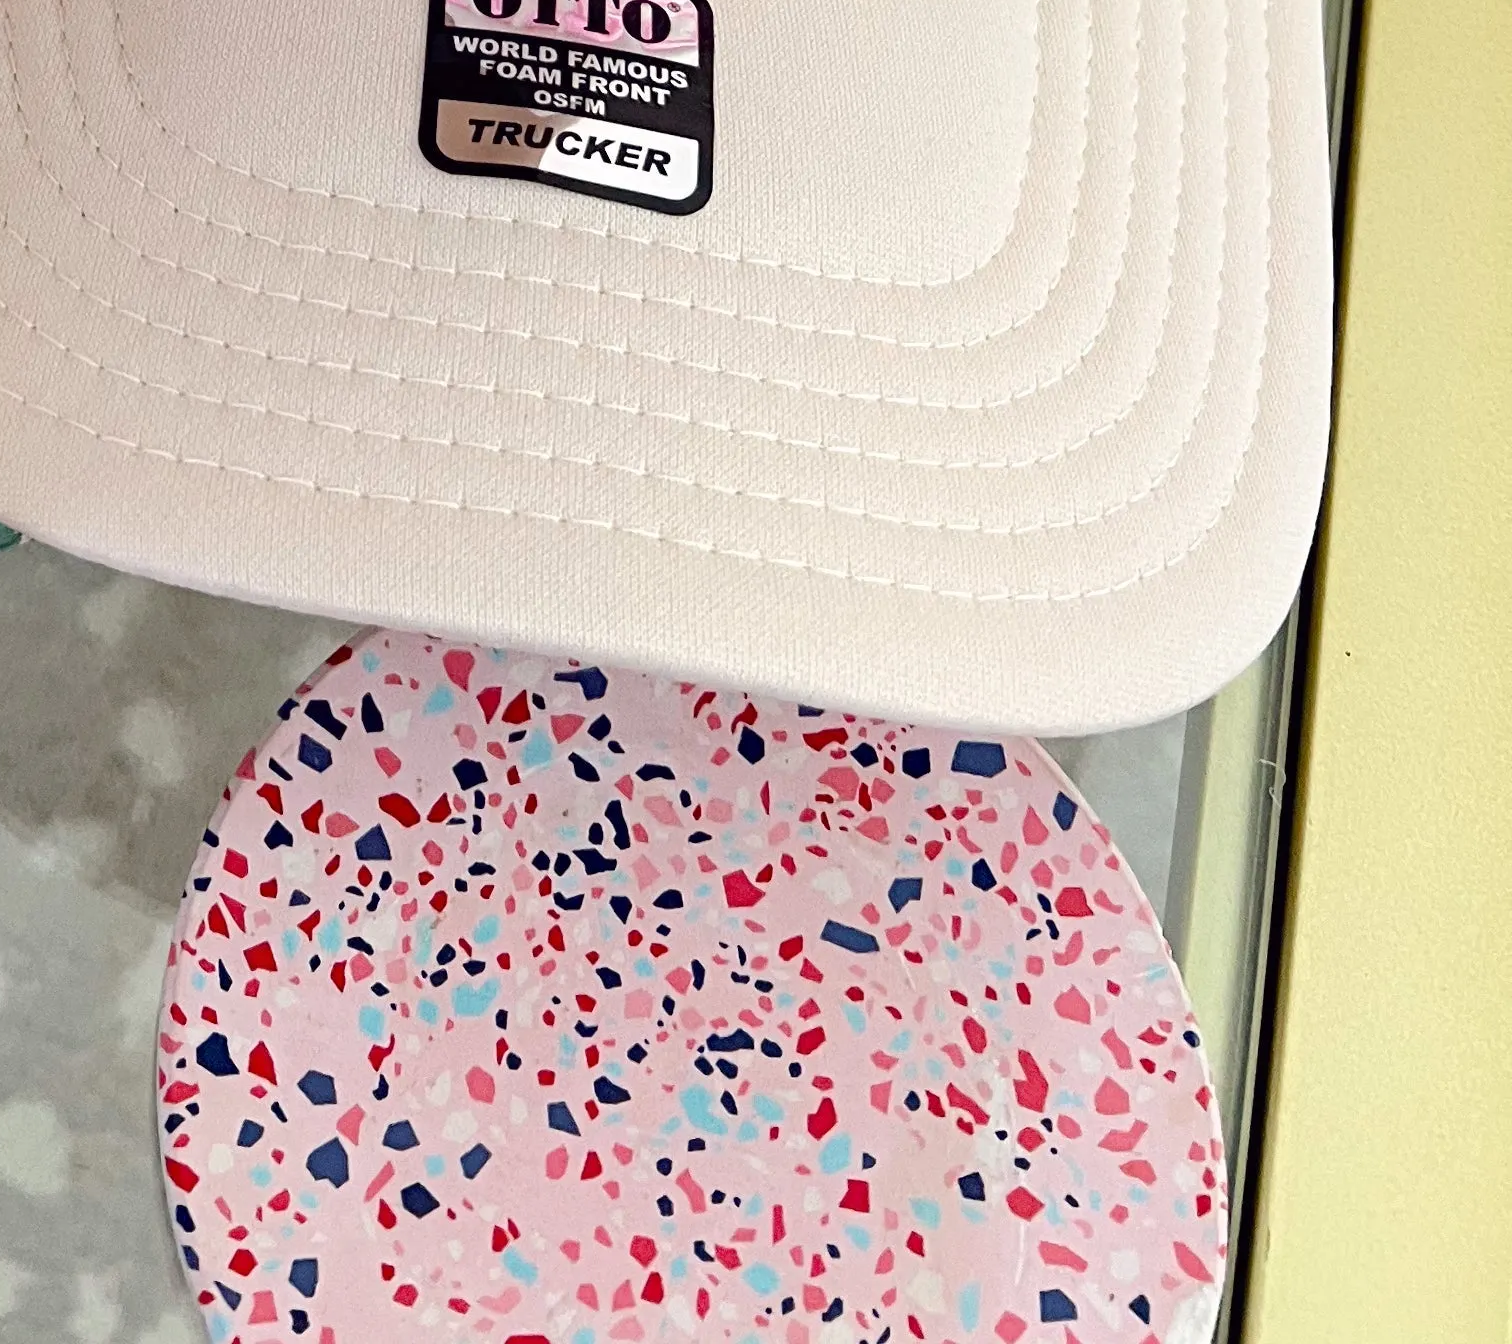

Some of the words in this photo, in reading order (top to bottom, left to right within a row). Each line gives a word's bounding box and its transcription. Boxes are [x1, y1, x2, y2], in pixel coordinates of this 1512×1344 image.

[453, 35, 558, 63] WORLD
[568, 49, 688, 89] FAMOUS
[480, 59, 562, 86] FOAM
[572, 72, 671, 106] FRONT
[534, 89, 607, 117] OSFM
[468, 118, 672, 176] TRUCKER
